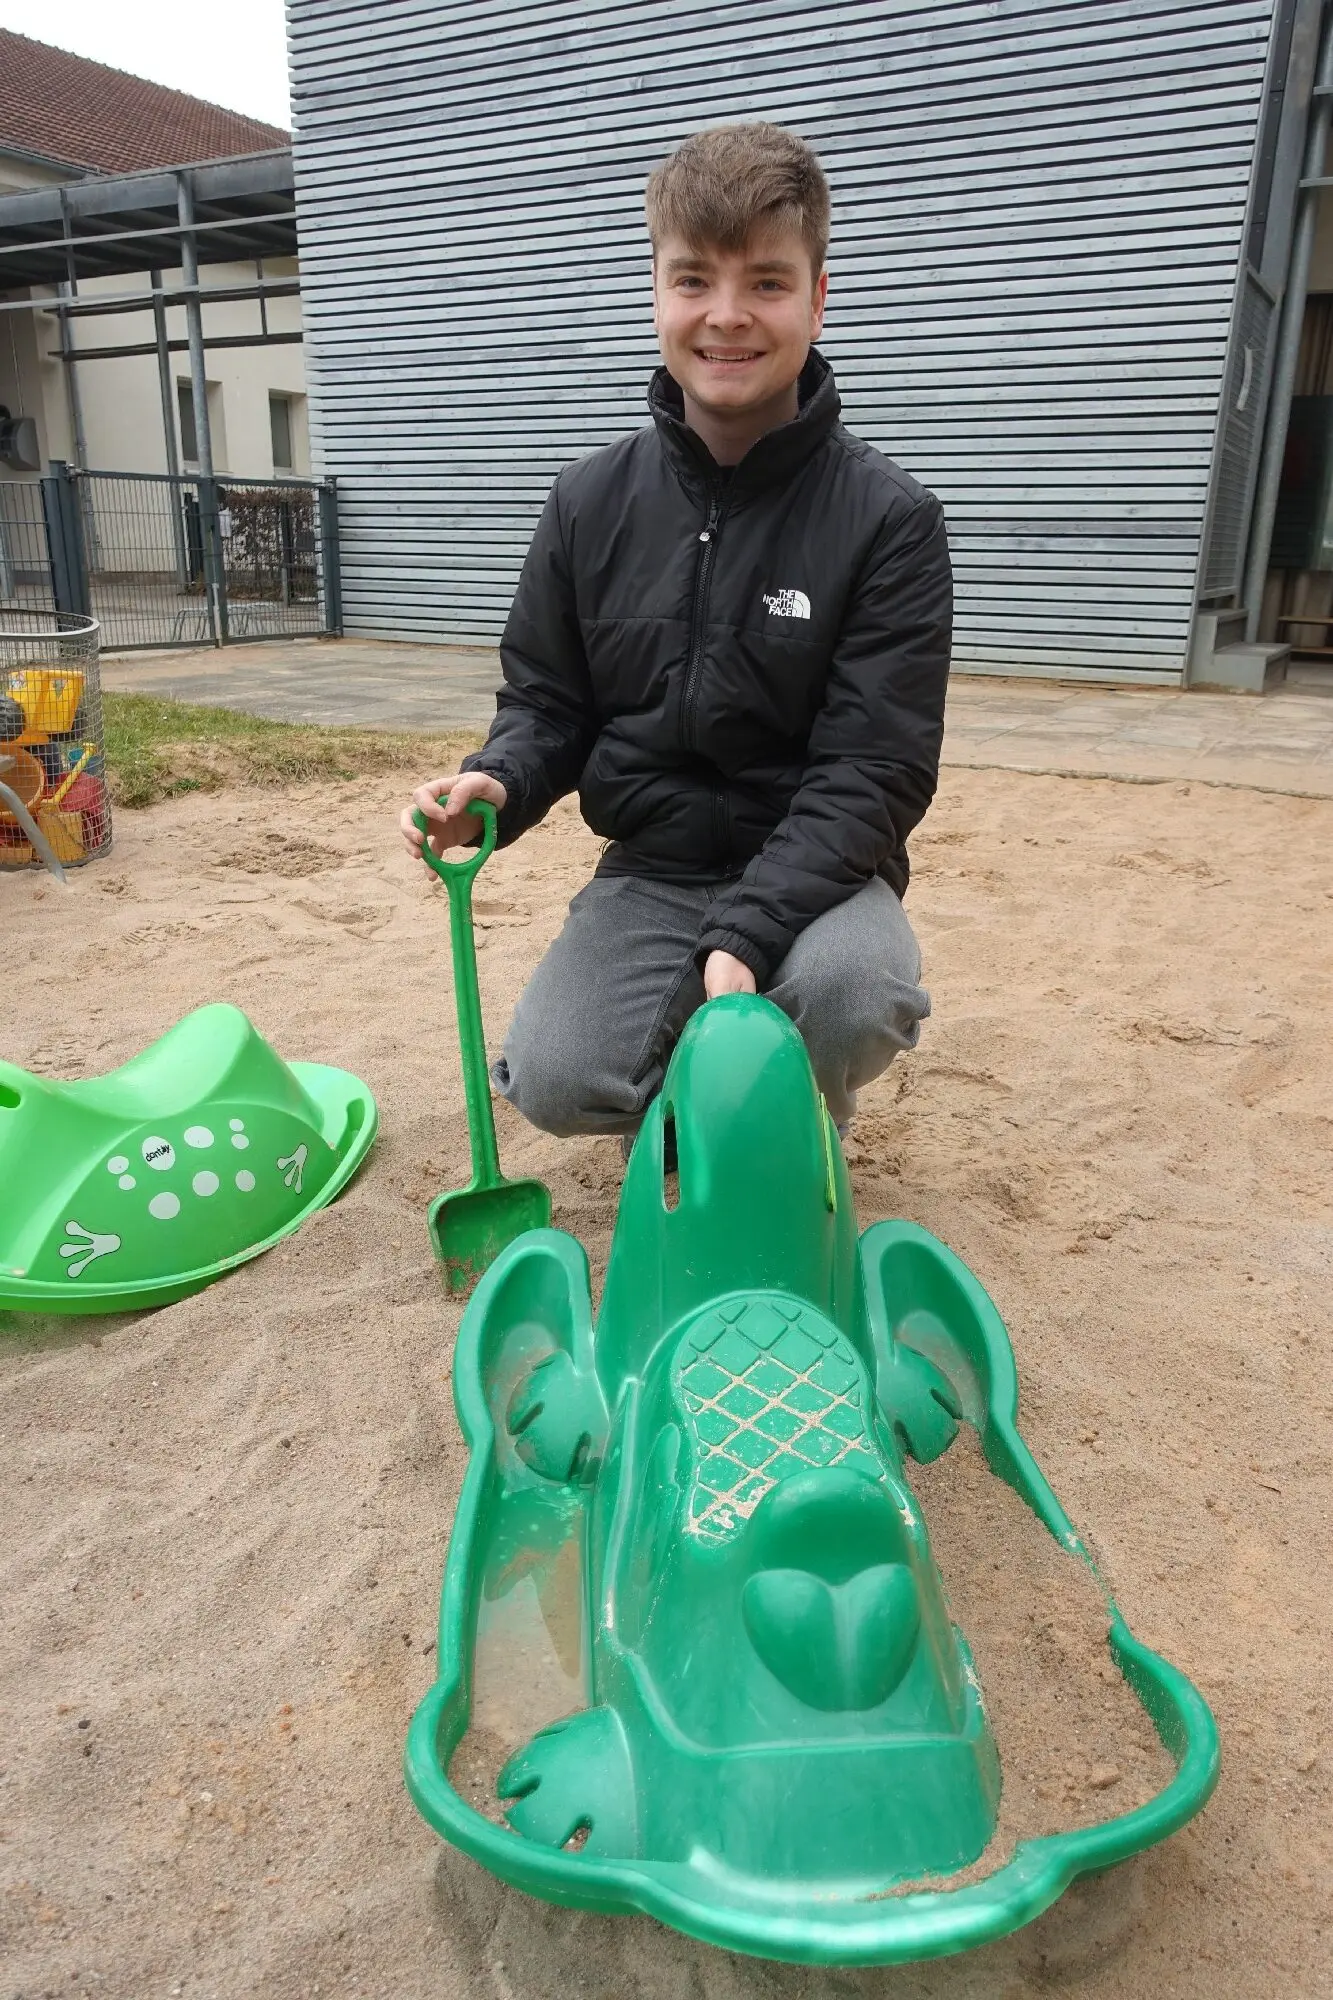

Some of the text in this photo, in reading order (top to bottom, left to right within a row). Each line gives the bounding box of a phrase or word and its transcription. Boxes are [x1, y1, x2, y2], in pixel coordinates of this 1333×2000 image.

[778, 589, 796, 599] THE
[762, 594, 794, 608] NORTH
[768, 606, 793, 617] FACE
